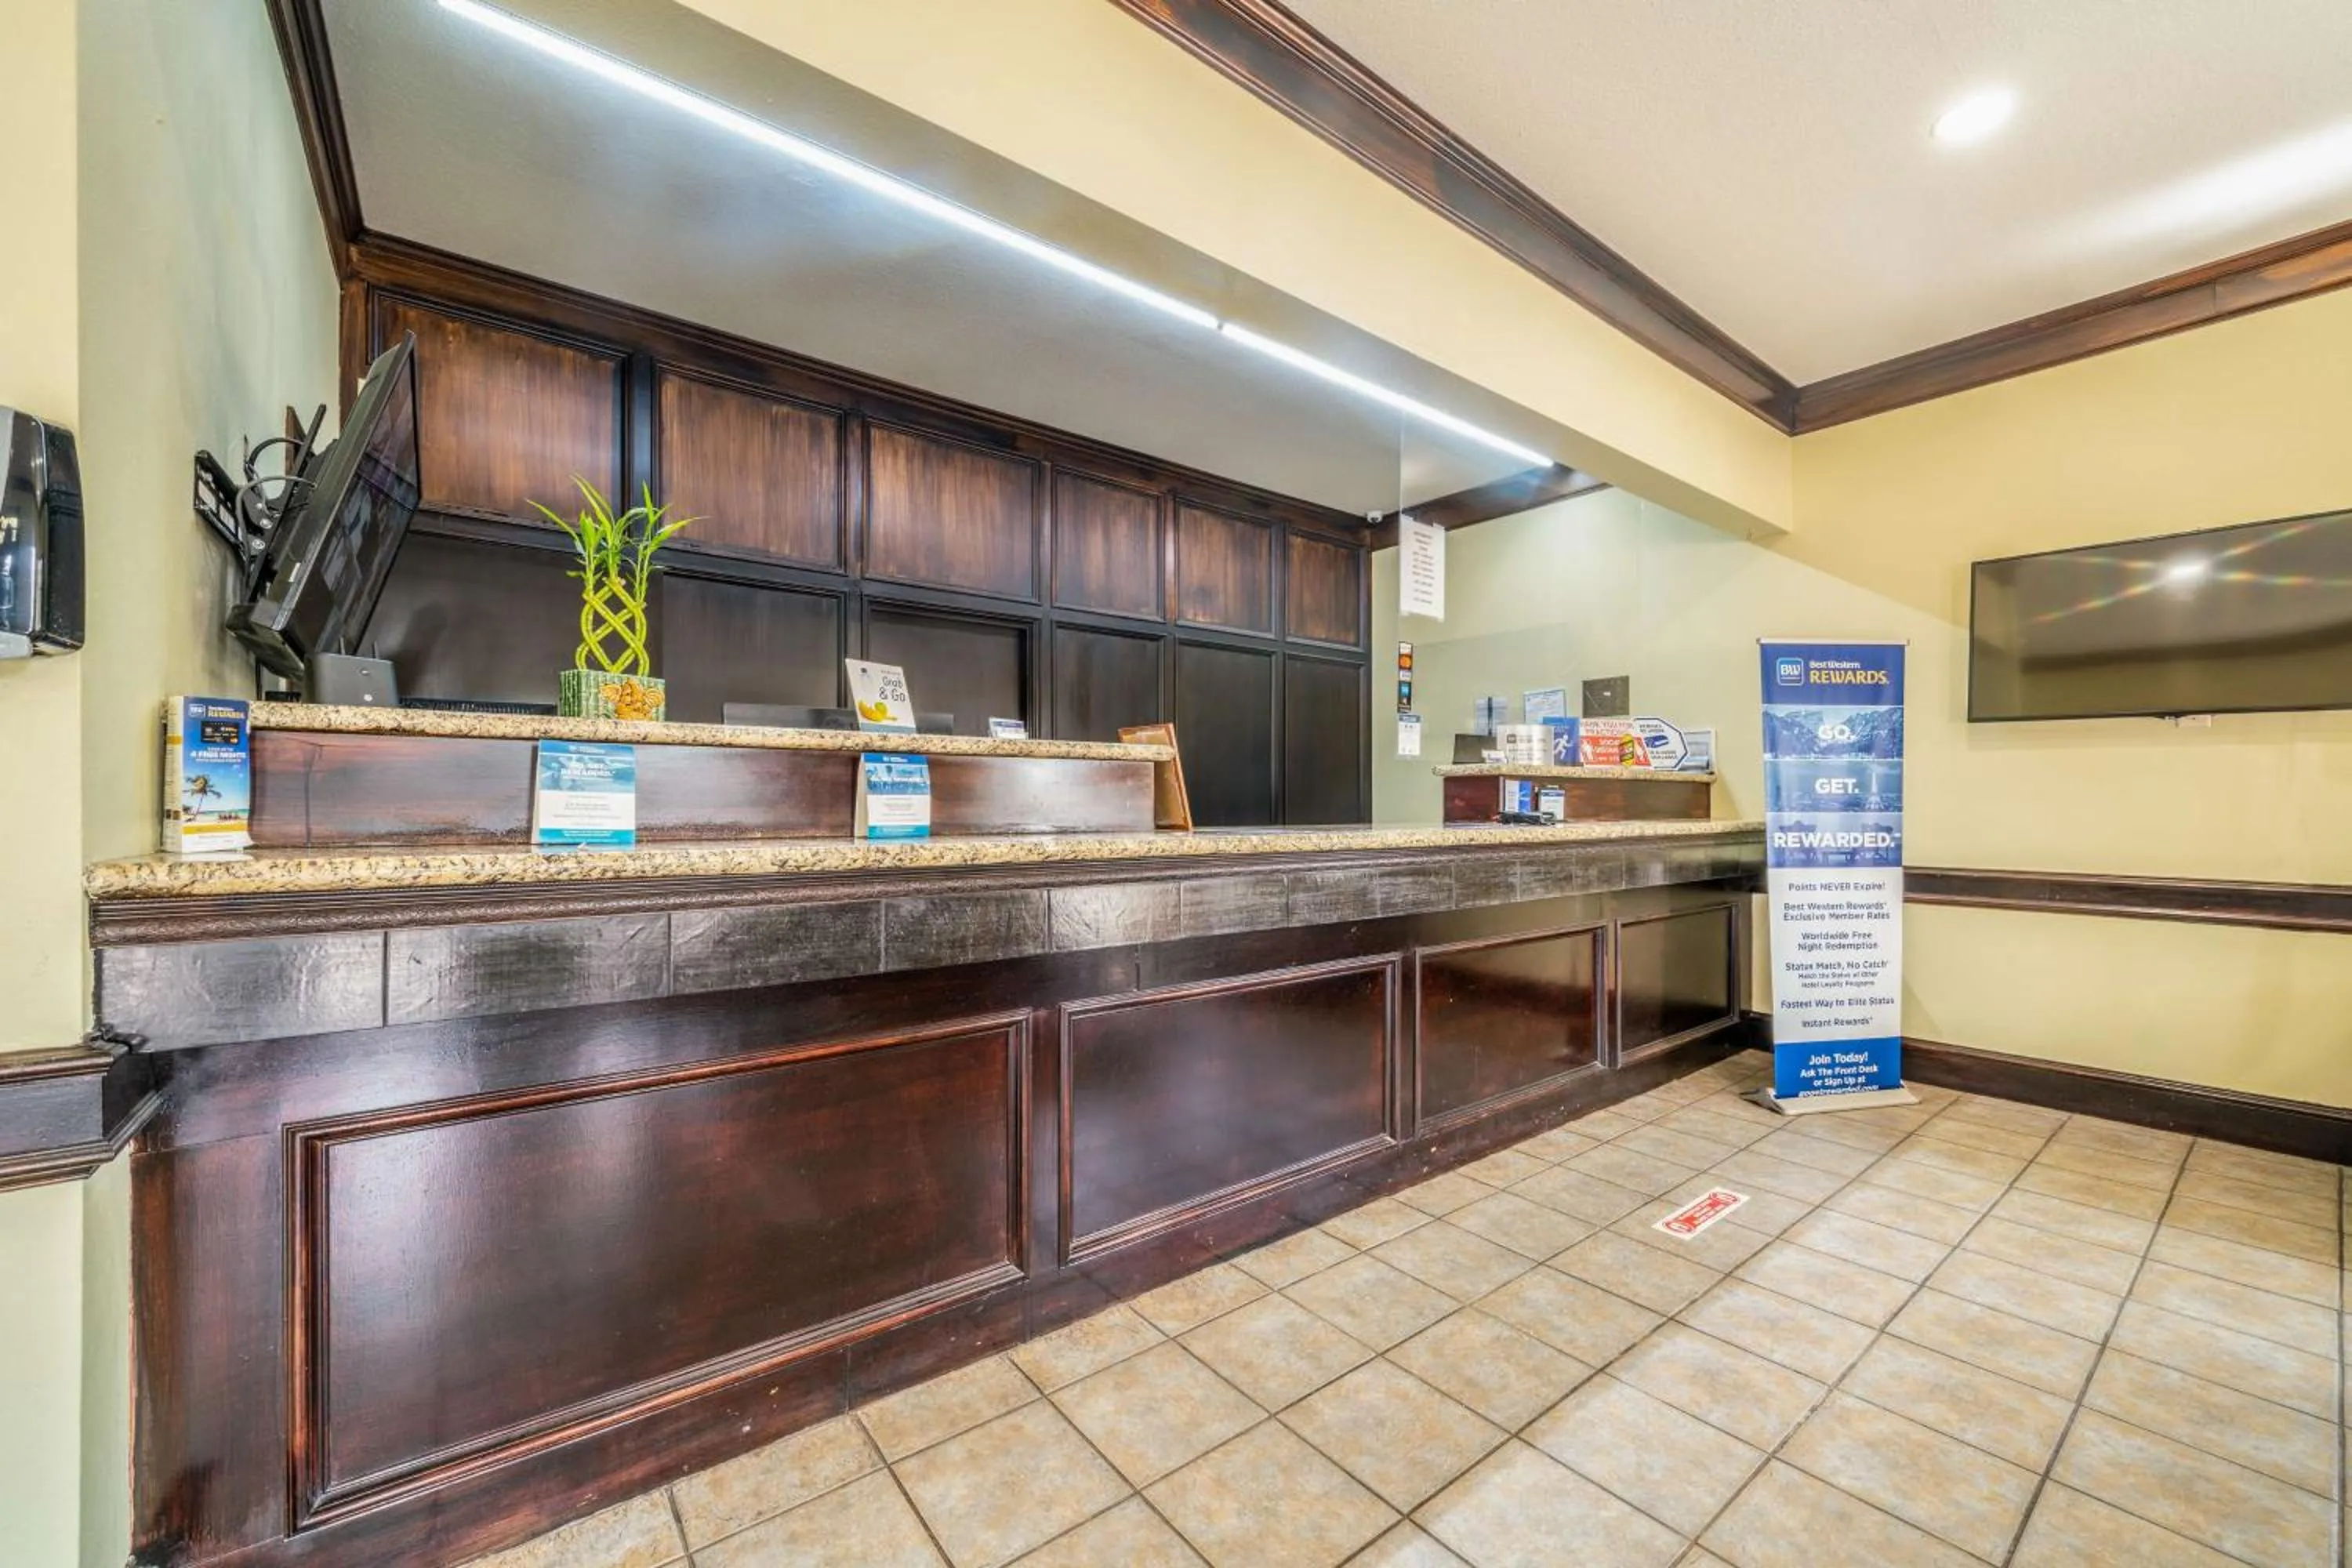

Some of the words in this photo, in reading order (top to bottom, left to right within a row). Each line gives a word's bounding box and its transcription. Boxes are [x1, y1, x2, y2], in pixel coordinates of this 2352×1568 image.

[882, 676, 904, 689] Grab
[878, 686, 888, 700] &
[891, 688, 906, 702] Go
[1815, 778, 1860, 795] GET.
[1788, 882, 1817, 891] Points
[1820, 882, 1851, 891] NEVER
[1784, 902, 1805, 911] Best
[1806, 902, 1845, 911] Western
[1784, 912, 1826, 921] Exclusive
[1828, 911, 1865, 920] Member
[1867, 910, 1890, 920] Rates
[1801, 931, 1849, 940] Worldwide
[1852, 931, 1873, 939] Free
[1798, 942, 1822, 953] Night
[1824, 941, 1878, 951] Redemption
[1784, 962, 1813, 971] Status
[1816, 961, 1845, 971] Match,
[1846, 961, 1860, 970] No
[1780, 1000, 1813, 1009] Fastest
[1815, 999, 1834, 1009] Way
[1835, 998, 1845, 1007] to
[1848, 997, 1867, 1006] Elite
[1868, 996, 1895, 1005] Status
[1802, 1019, 1831, 1028] Instant
[1809, 1054, 1831, 1065] Join
[1833, 1051, 1868, 1064] Today!
[1800, 1069, 1816, 1078] Ask
[1817, 1067, 1833, 1076] The
[1835, 1065, 1857, 1075] Front
[1858, 1063, 1878, 1073] Desk
[1824, 1076, 1842, 1087] Sign
[1844, 1076, 1856, 1085] Up
[1857, 1075, 1866, 1083] at
